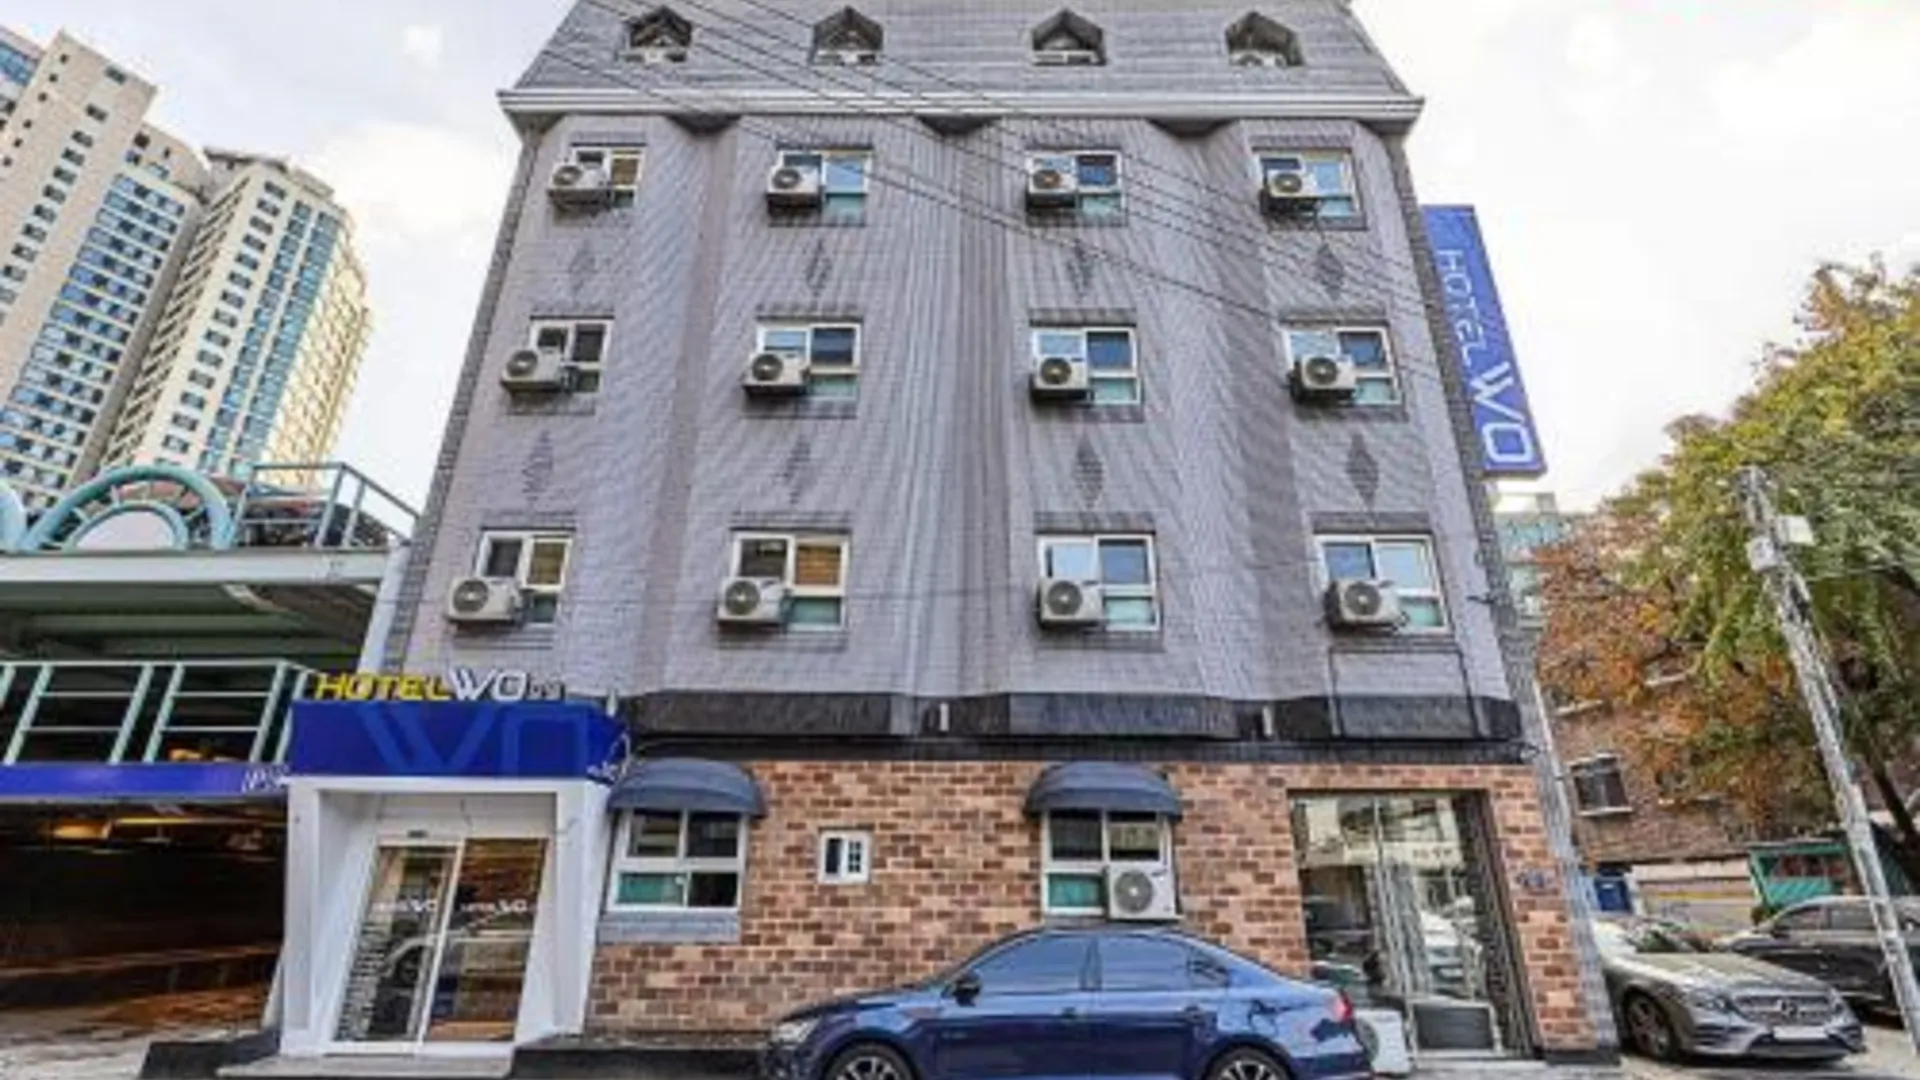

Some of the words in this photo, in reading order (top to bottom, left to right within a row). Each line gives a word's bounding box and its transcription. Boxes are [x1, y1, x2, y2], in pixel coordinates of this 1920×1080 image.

[1438, 248, 1487, 368] HOTEL
[1470, 361, 1534, 463] WO
[315, 672, 450, 700] HOTEL
[451, 668, 528, 701] WO
